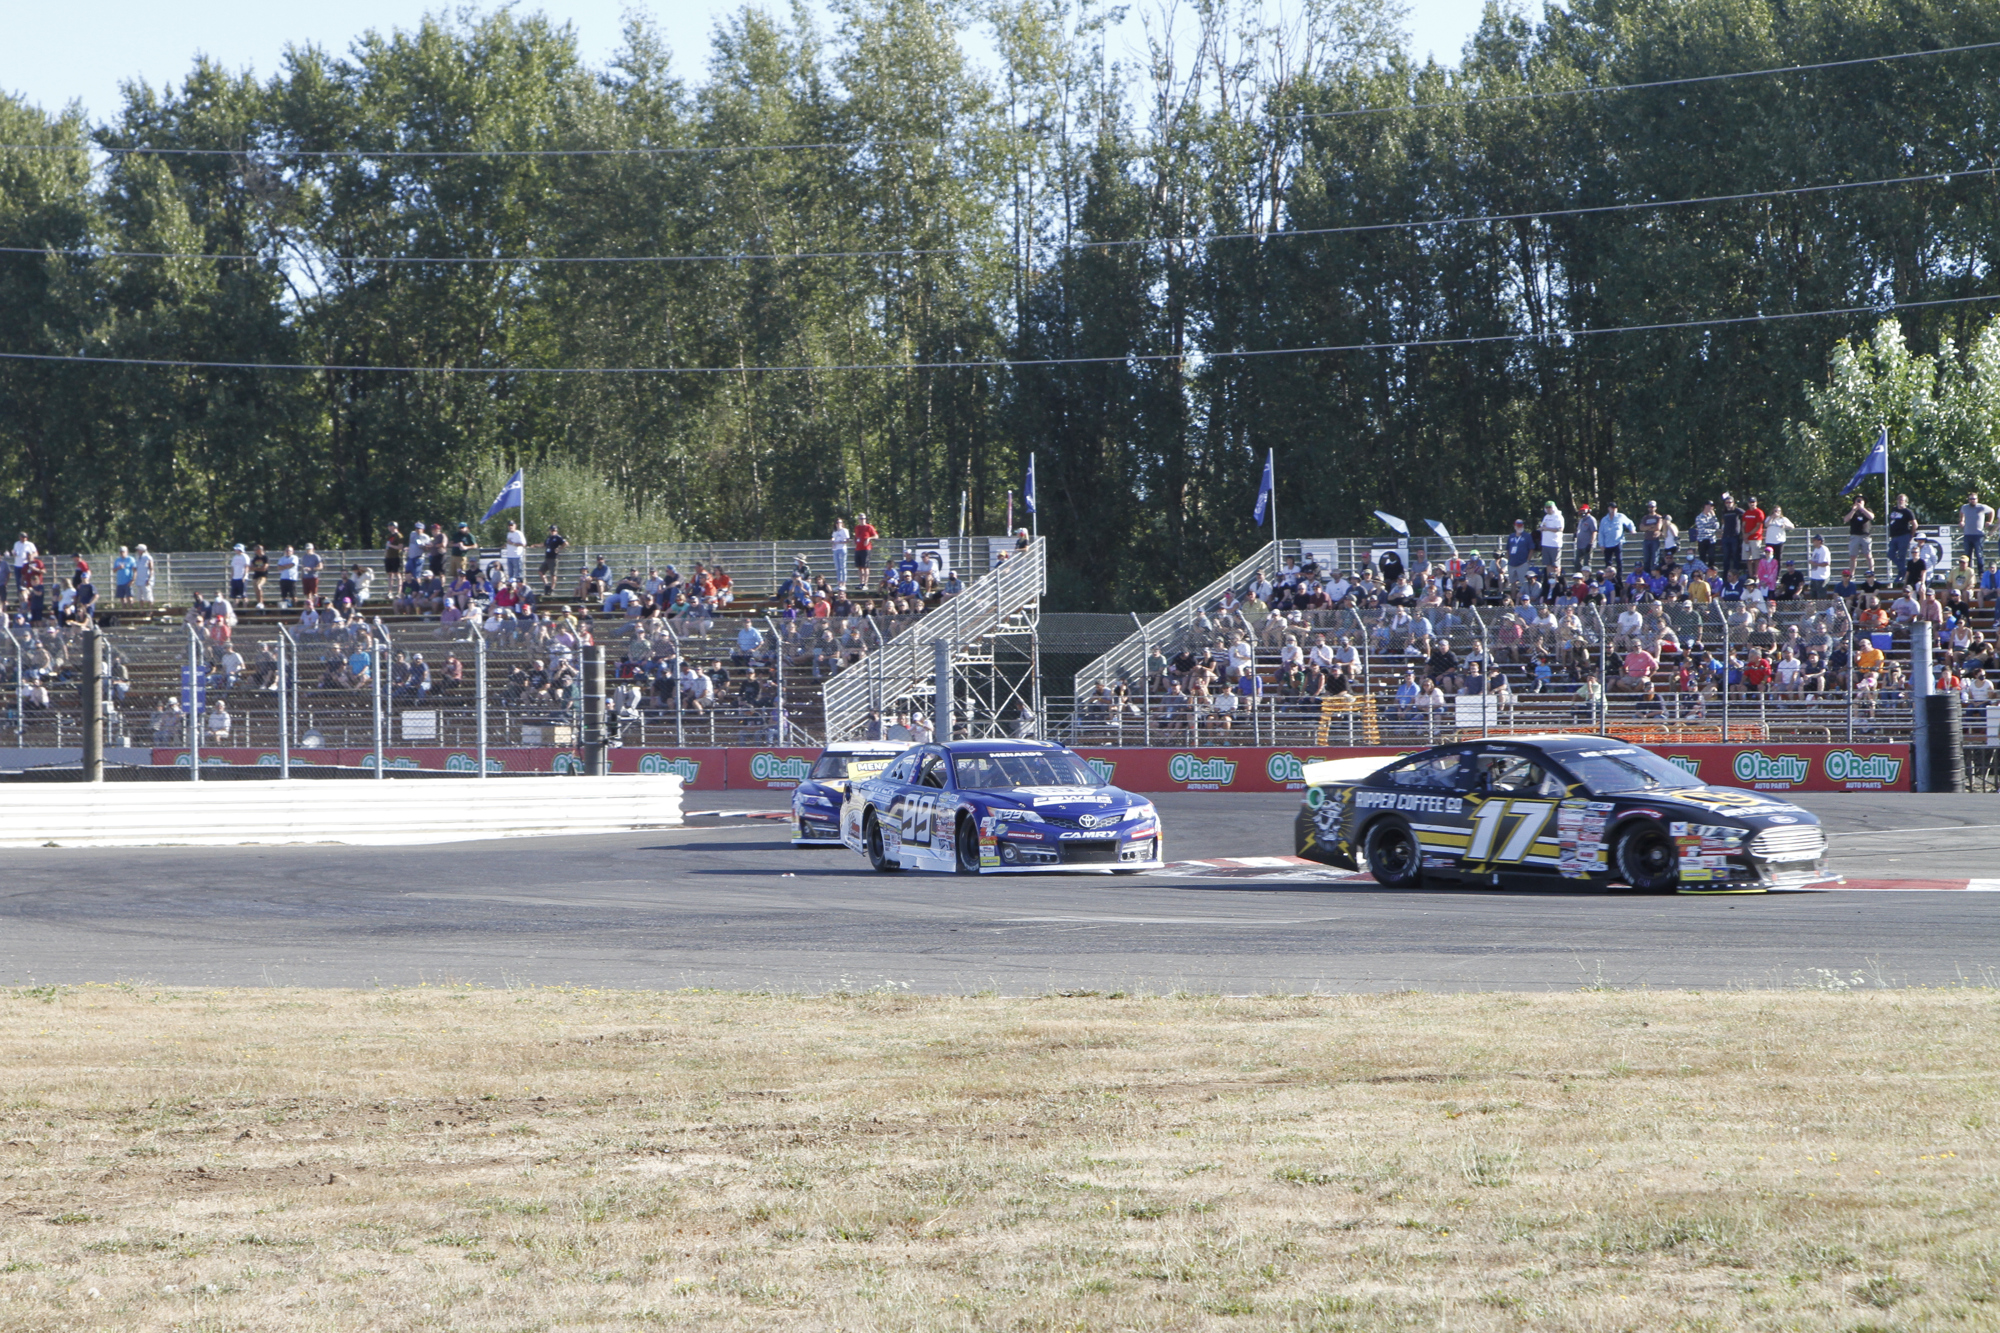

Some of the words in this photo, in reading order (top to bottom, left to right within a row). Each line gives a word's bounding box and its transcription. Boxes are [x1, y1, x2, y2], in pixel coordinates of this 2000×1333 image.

[751, 754, 812, 782] O'Reilly
[1169, 753, 1237, 784] O'Reilly
[1735, 752, 1809, 784] O'Reilly
[1825, 751, 1900, 783] O'Reilly
[1846, 781, 1862, 789] AUTO
[1862, 781, 1882, 789] PARTS
[1002, 810, 1024, 820] 99
[1355, 791, 1397, 809] RIPPER
[1396, 794, 1446, 813] COFFEE
[1445, 797, 1463, 814] CO
[1059, 830, 1117, 839] CAMRY
[1465, 799, 1557, 862] 17
[1697, 824, 1719, 836] 17
